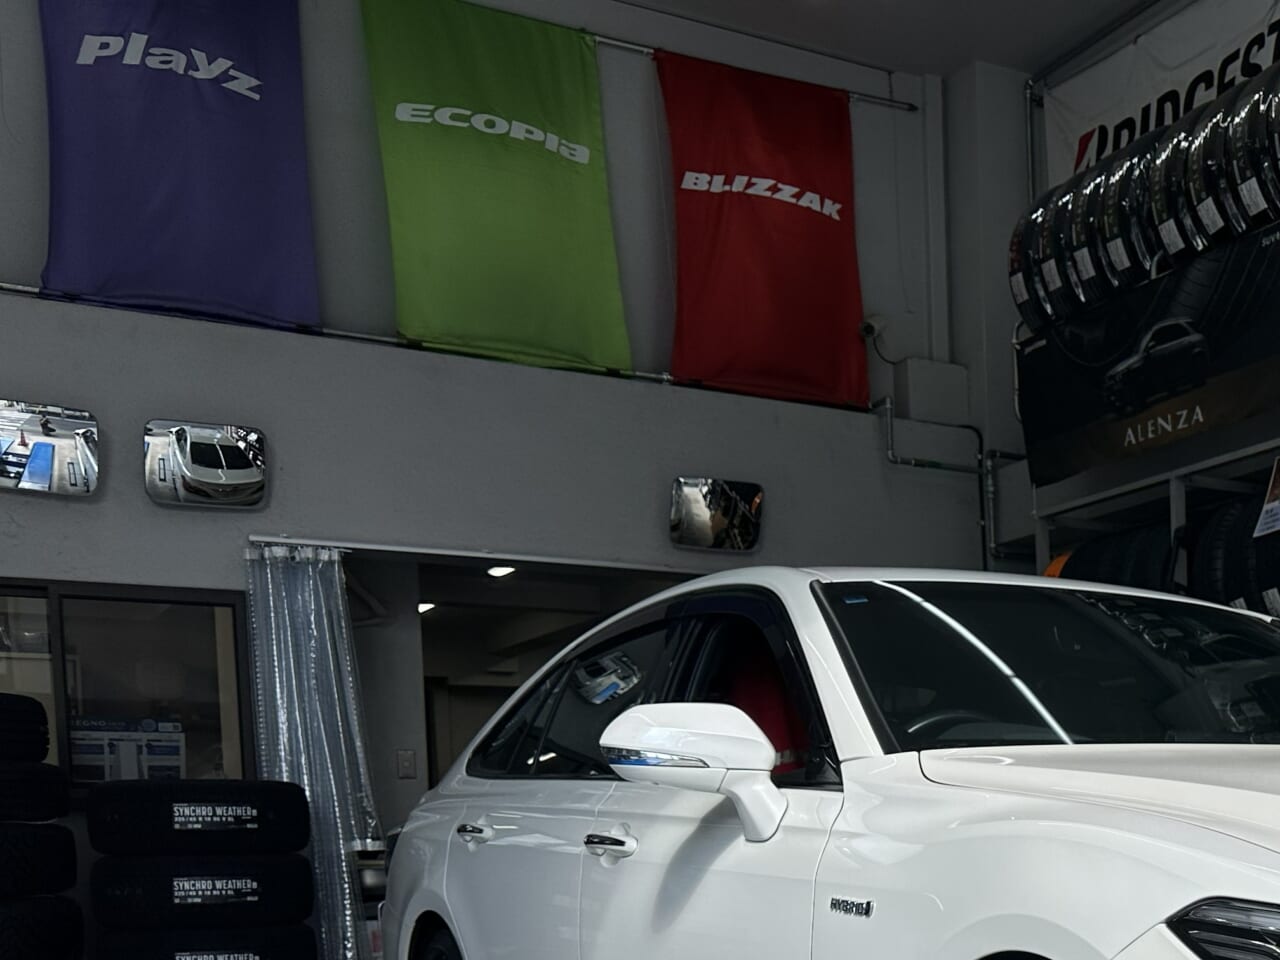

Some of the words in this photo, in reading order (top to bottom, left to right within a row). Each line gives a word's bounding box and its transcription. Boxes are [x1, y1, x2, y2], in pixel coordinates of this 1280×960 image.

[74, 32, 263, 101] Playz
[681, 169, 842, 222] BLIZZAK
[1123, 405, 1205, 447] ALENZA
[173, 806, 213, 817] SYNCHRO
[214, 805, 252, 817] WEATHER
[173, 880, 213, 890] SYNCHRO
[214, 879, 252, 890] WEATHER
